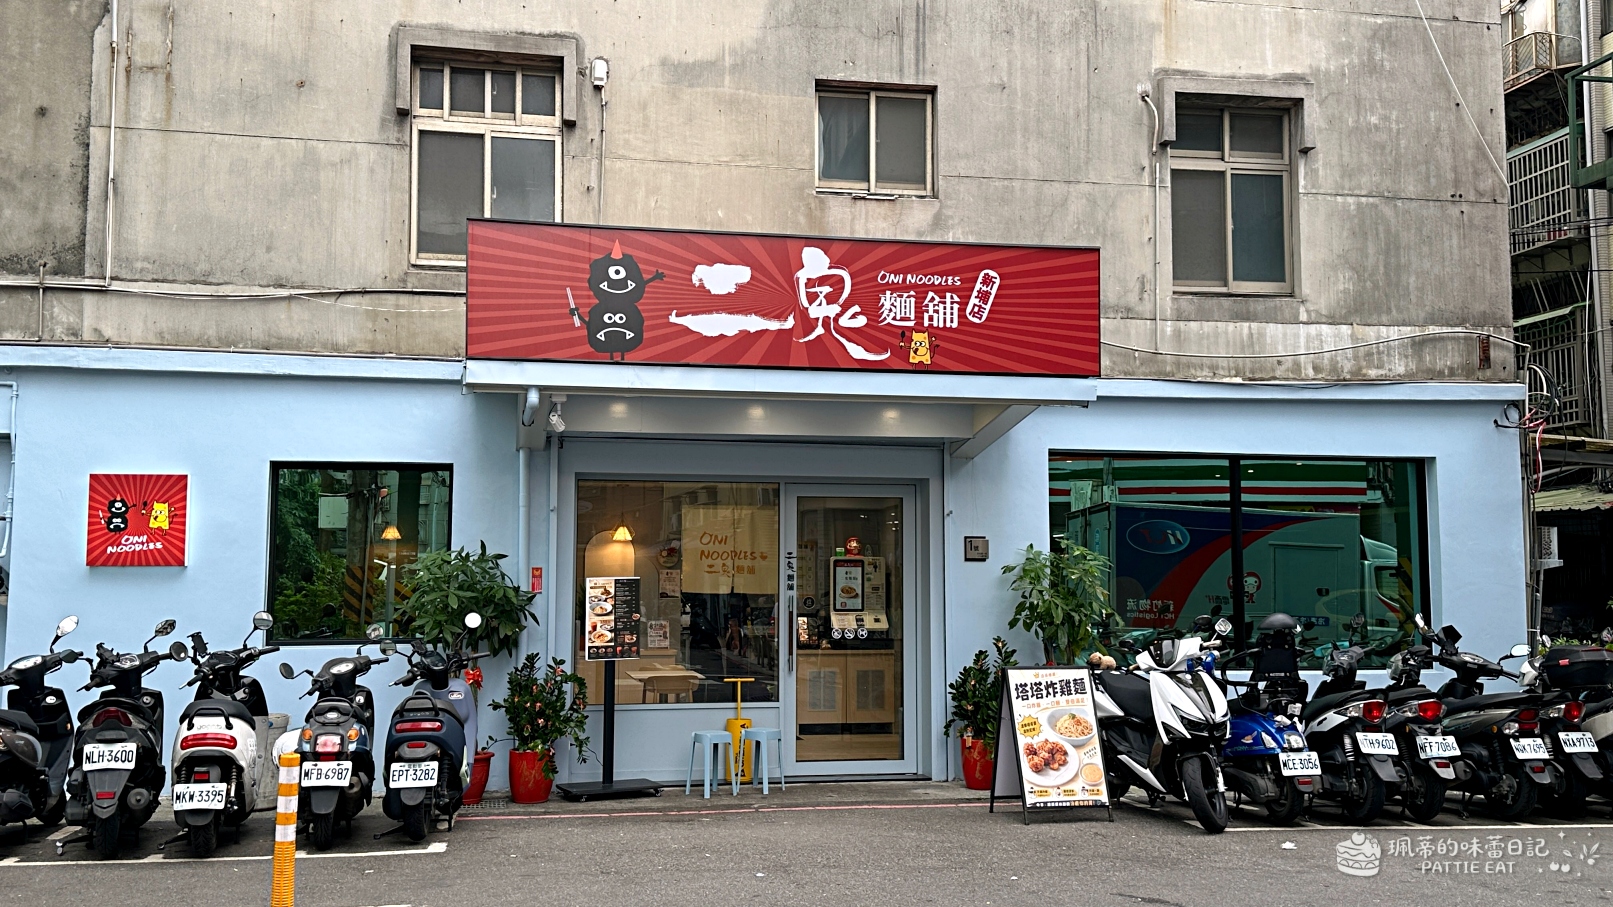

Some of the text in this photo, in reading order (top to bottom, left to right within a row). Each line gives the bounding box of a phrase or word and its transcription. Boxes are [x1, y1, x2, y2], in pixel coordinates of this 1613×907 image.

[877, 270, 961, 286] ONI NOODLES
[668, 246, 960, 360] 二鬼 麵舖
[968, 272, 997, 320] 新埔店
[121, 535, 148, 545] ONI
[700, 531, 728, 546] ONI
[106, 541, 163, 555] NOODLES
[700, 549, 757, 562] NOODLES
[1015, 678, 1087, 701] 塔塔炸雞麵
